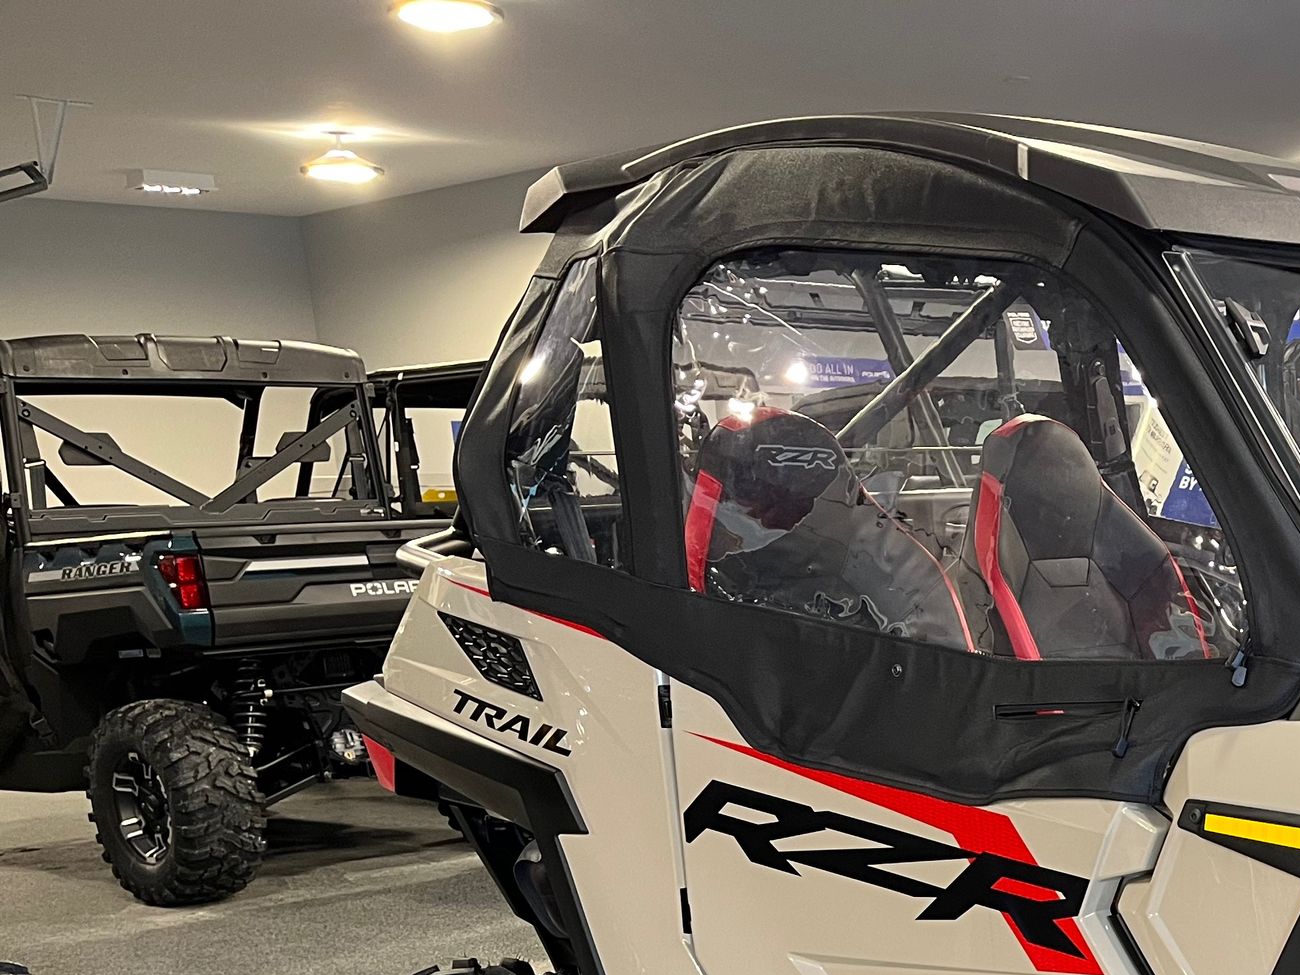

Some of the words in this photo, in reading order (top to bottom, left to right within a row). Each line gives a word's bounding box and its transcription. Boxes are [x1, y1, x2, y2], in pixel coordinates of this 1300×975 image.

[61, 561, 132, 580] RANGER
[453, 688, 572, 757] TRAIL
[683, 779, 1091, 960] RZR
